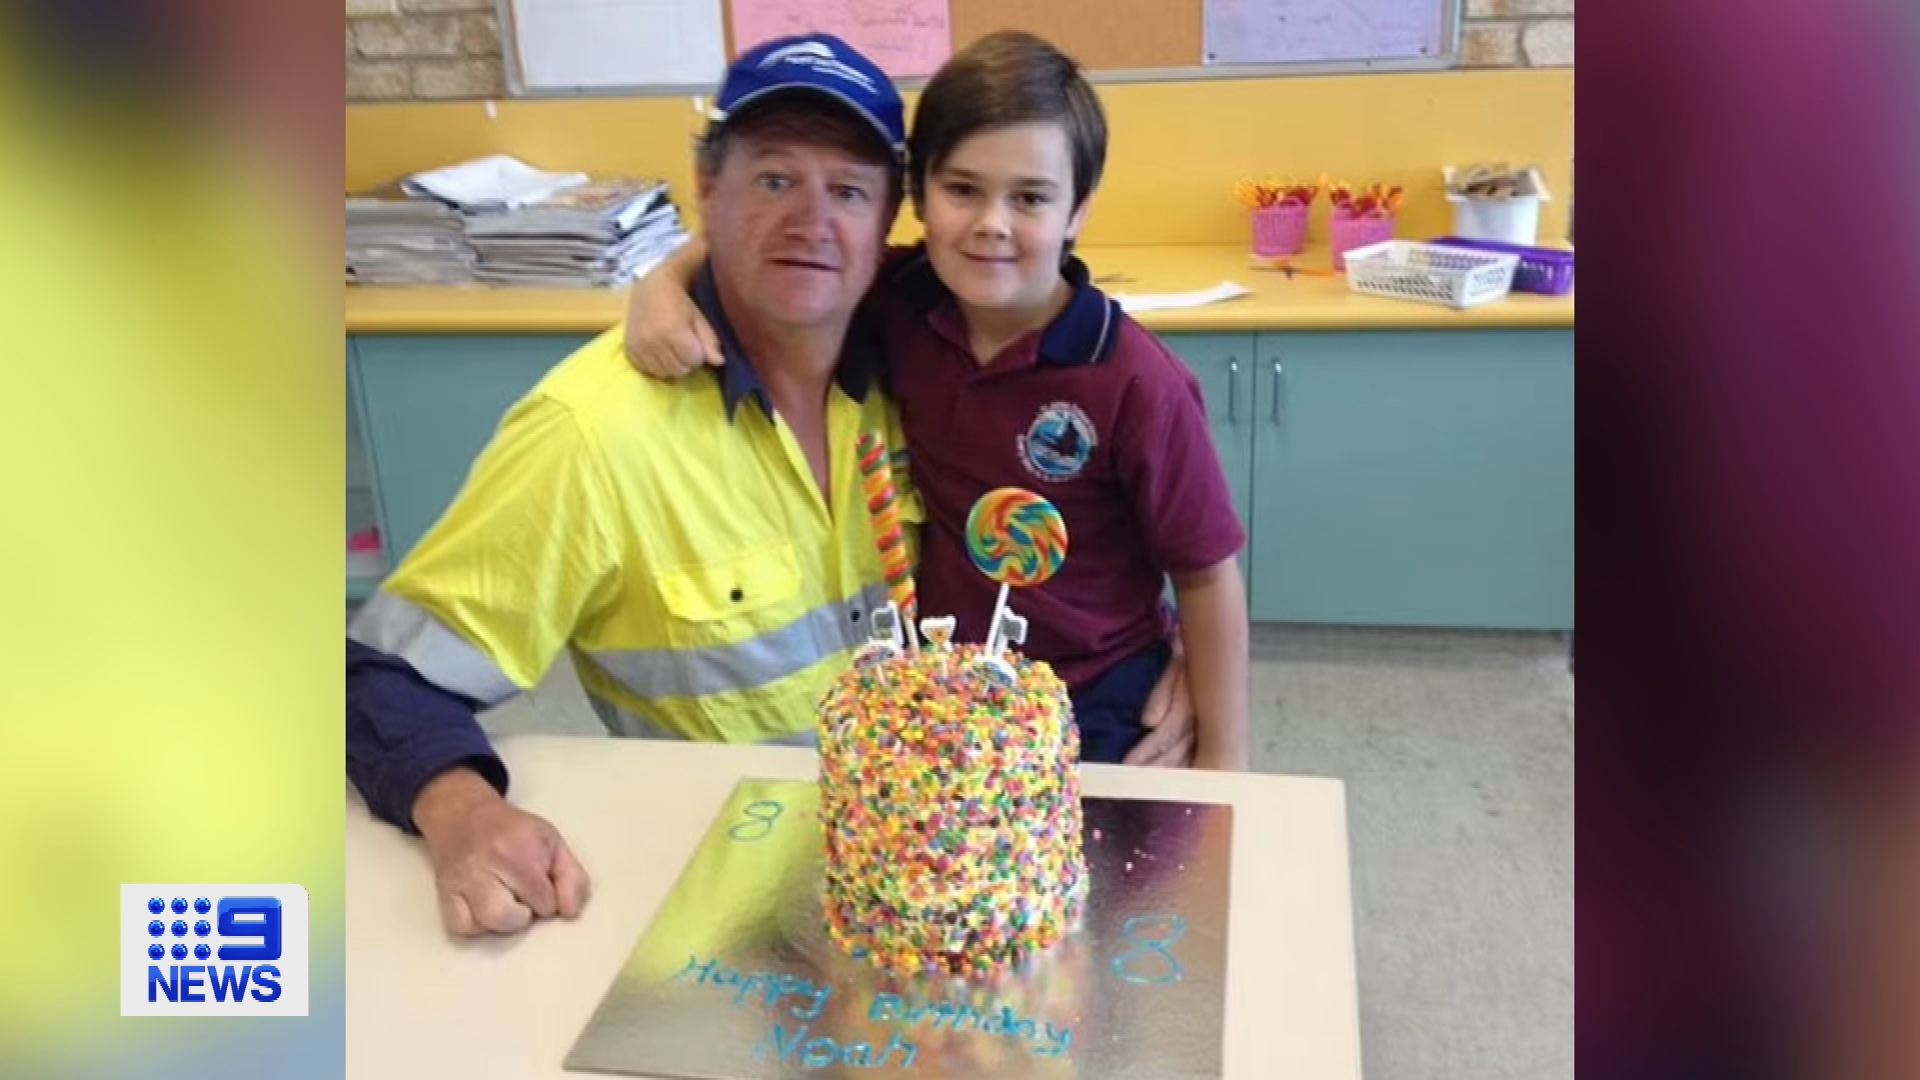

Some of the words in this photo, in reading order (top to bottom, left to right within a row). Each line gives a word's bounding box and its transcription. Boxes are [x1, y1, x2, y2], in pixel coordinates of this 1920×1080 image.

[727, 800, 783, 842] 8
[1109, 912, 1187, 985] 8
[674, 953, 832, 1020] Happy
[868, 991, 1072, 1056] Birthday
[754, 1022, 917, 1068] Noah
